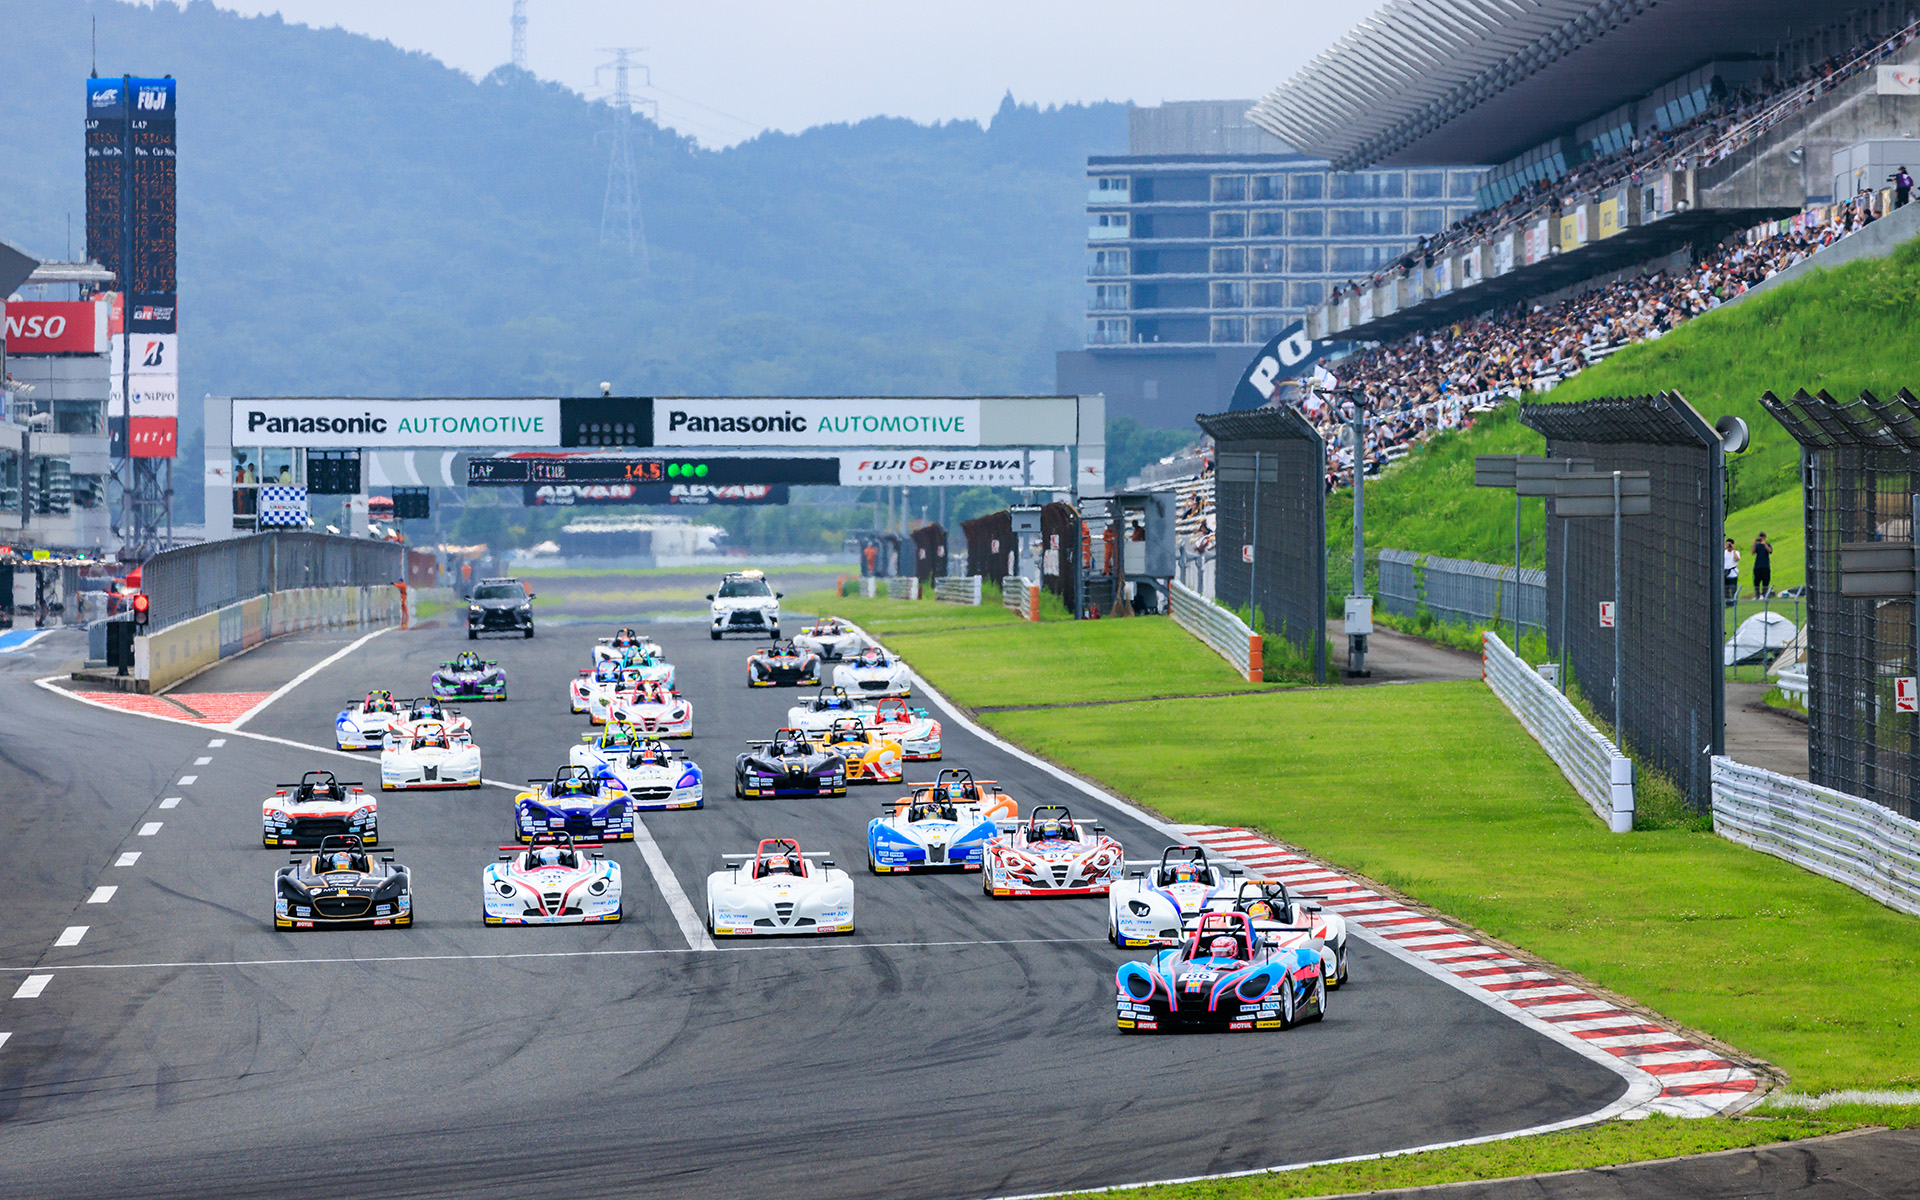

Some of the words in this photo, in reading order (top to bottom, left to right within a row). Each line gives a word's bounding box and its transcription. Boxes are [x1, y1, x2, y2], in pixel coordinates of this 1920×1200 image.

[138, 92, 166, 110] FUJI
[87, 120, 99, 129] LAP
[132, 120, 147, 129] LAP
[144, 391, 175, 401] NIPPO
[248, 411, 387, 433] Panasonic
[398, 417, 545, 433] AUTOMOTIVE
[669, 411, 807, 433] Panasonic
[817, 416, 965, 433] AUTOMOTIVE
[471, 464, 494, 478] LAP
[624, 463, 662, 479] 14.5
[858, 460, 907, 471] FUJI
[536, 485, 635, 498] ADVAN
[670, 485, 770, 498] ADVAN
